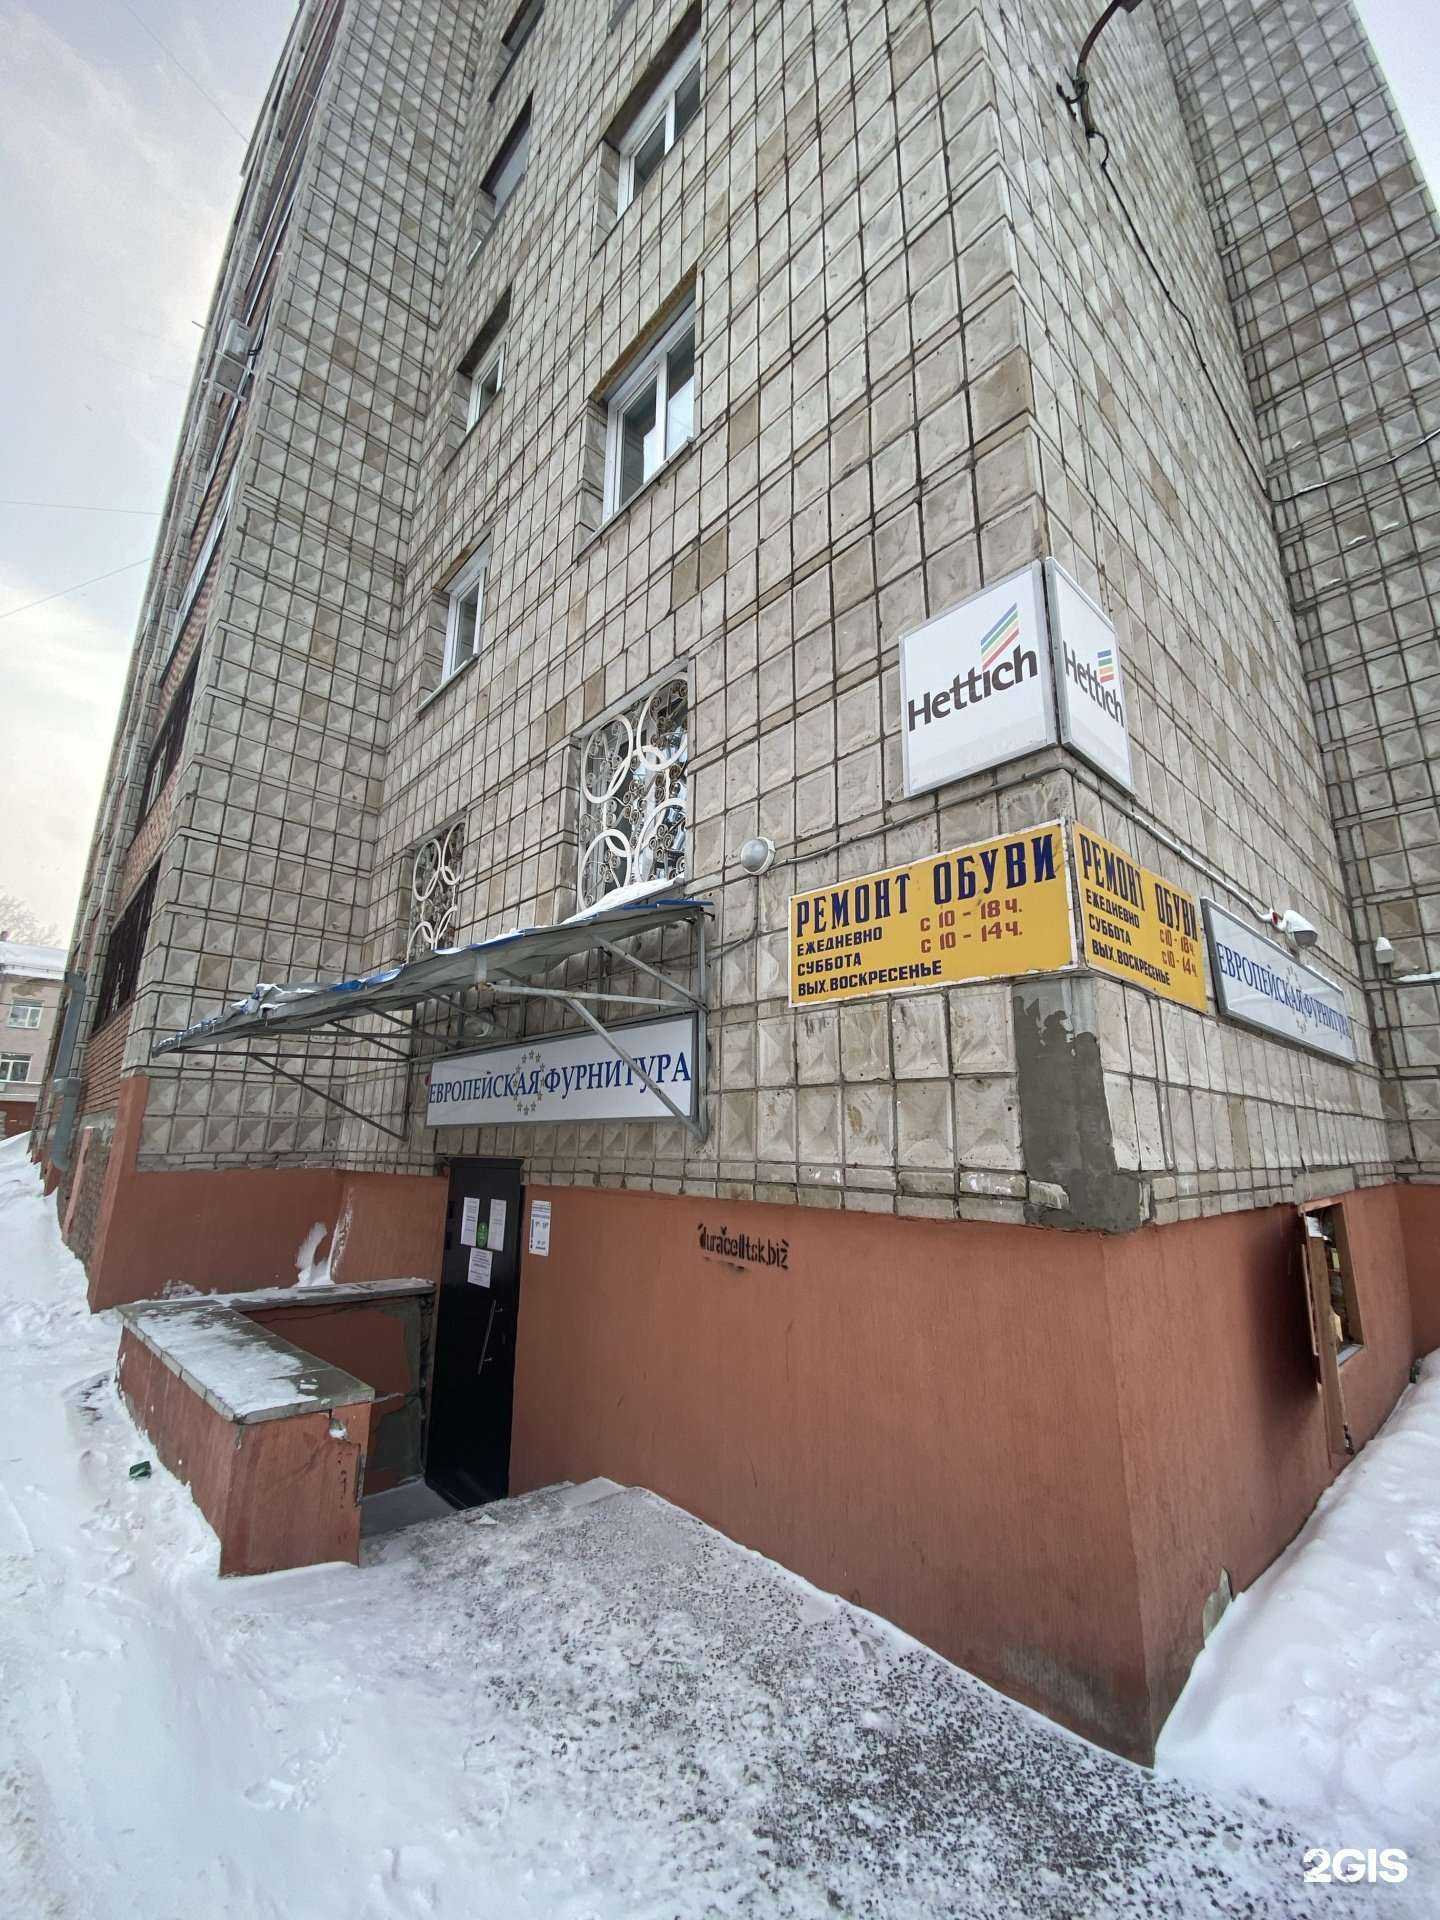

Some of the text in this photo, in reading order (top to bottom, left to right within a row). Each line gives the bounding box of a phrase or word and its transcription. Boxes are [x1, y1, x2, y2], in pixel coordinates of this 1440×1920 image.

[908, 643, 1038, 732] Hettich
[1063, 640, 1125, 728] Hettich
[796, 834, 1056, 938] РЕМОНТ ОБУВИ
[1079, 832, 1198, 942] РЕМОНТ ОБУВИ
[1086, 888, 1140, 929] ЕЖЕДНЕВНО
[797, 926, 883, 957] ЕЖЕДНЕВНО
[938, 909, 955, 929] 10
[980, 901, 1000, 920] 18
[798, 952, 862, 977] СУББОТА
[940, 932, 956, 950] 10
[981, 922, 1002, 942] 14
[1089, 914, 1131, 946] СУББОТА
[1216, 941, 1304, 1015] ЕВРОПЕЙСКАЯ
[429, 1051, 691, 1104] ЕВРОПЕЙСКАЯ ФУРНИТУРА
